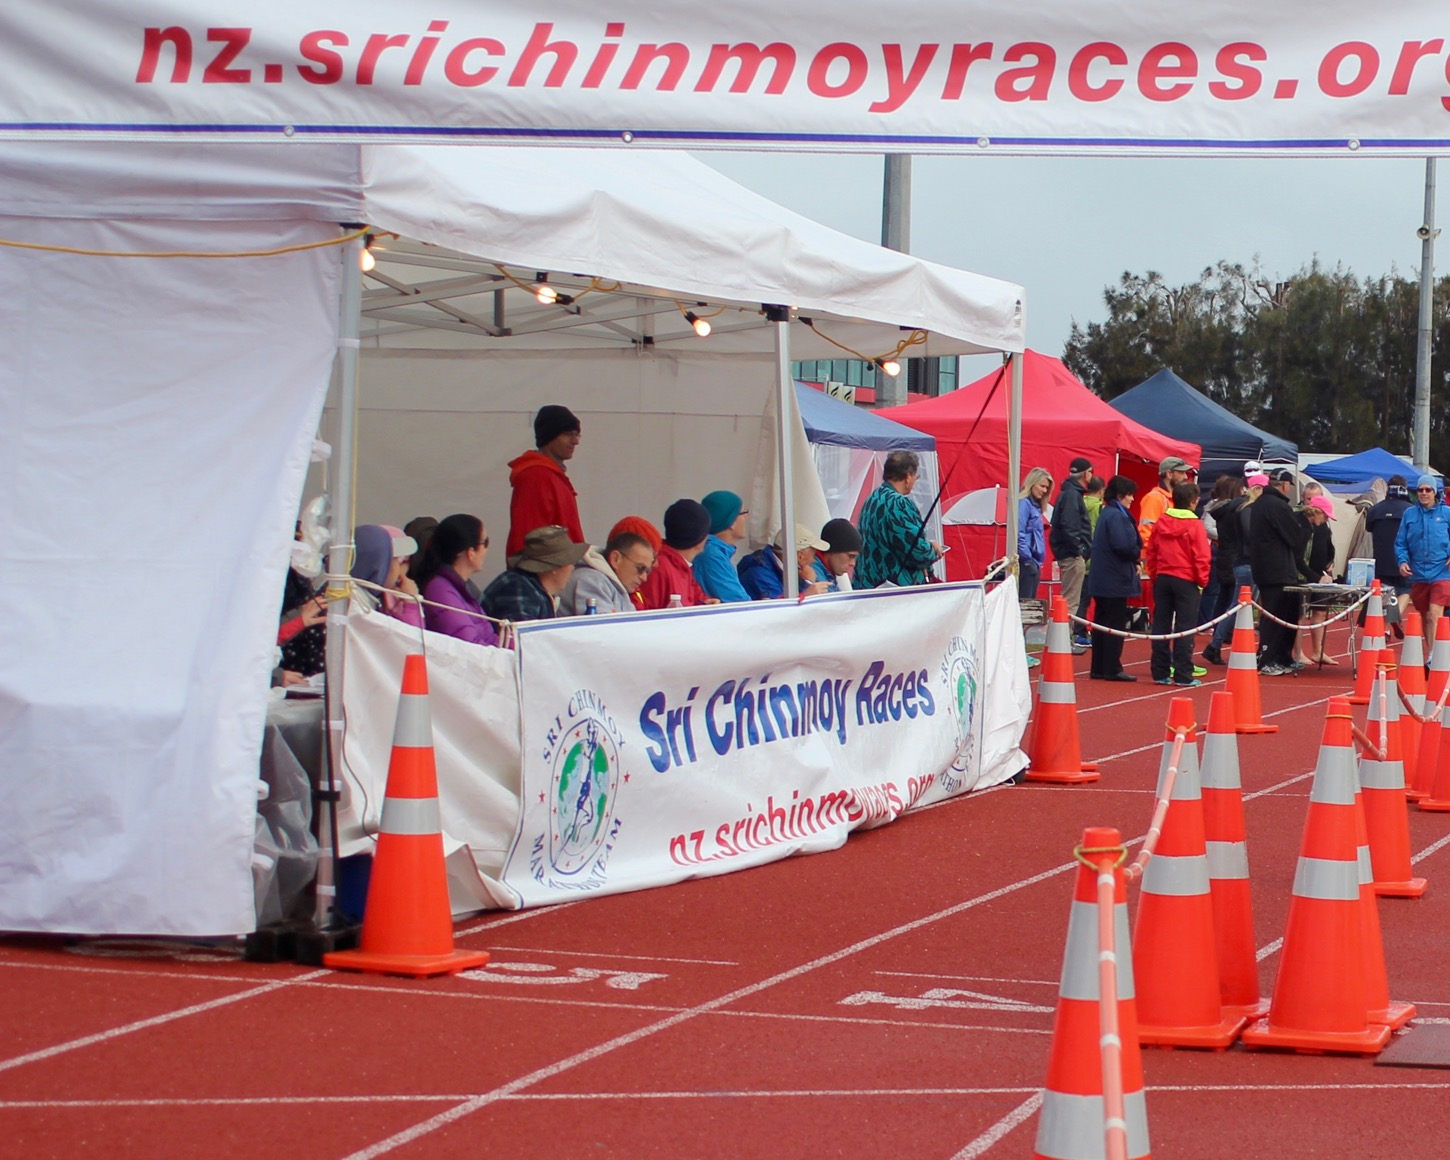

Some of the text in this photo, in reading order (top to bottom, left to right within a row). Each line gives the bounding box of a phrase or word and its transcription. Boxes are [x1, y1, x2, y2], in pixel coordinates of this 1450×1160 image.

[948, 636, 980, 672] CHINMO
[543, 688, 626, 764] SRI CHINMOY
[639, 660, 936, 773] Sri Chinmoy Races
